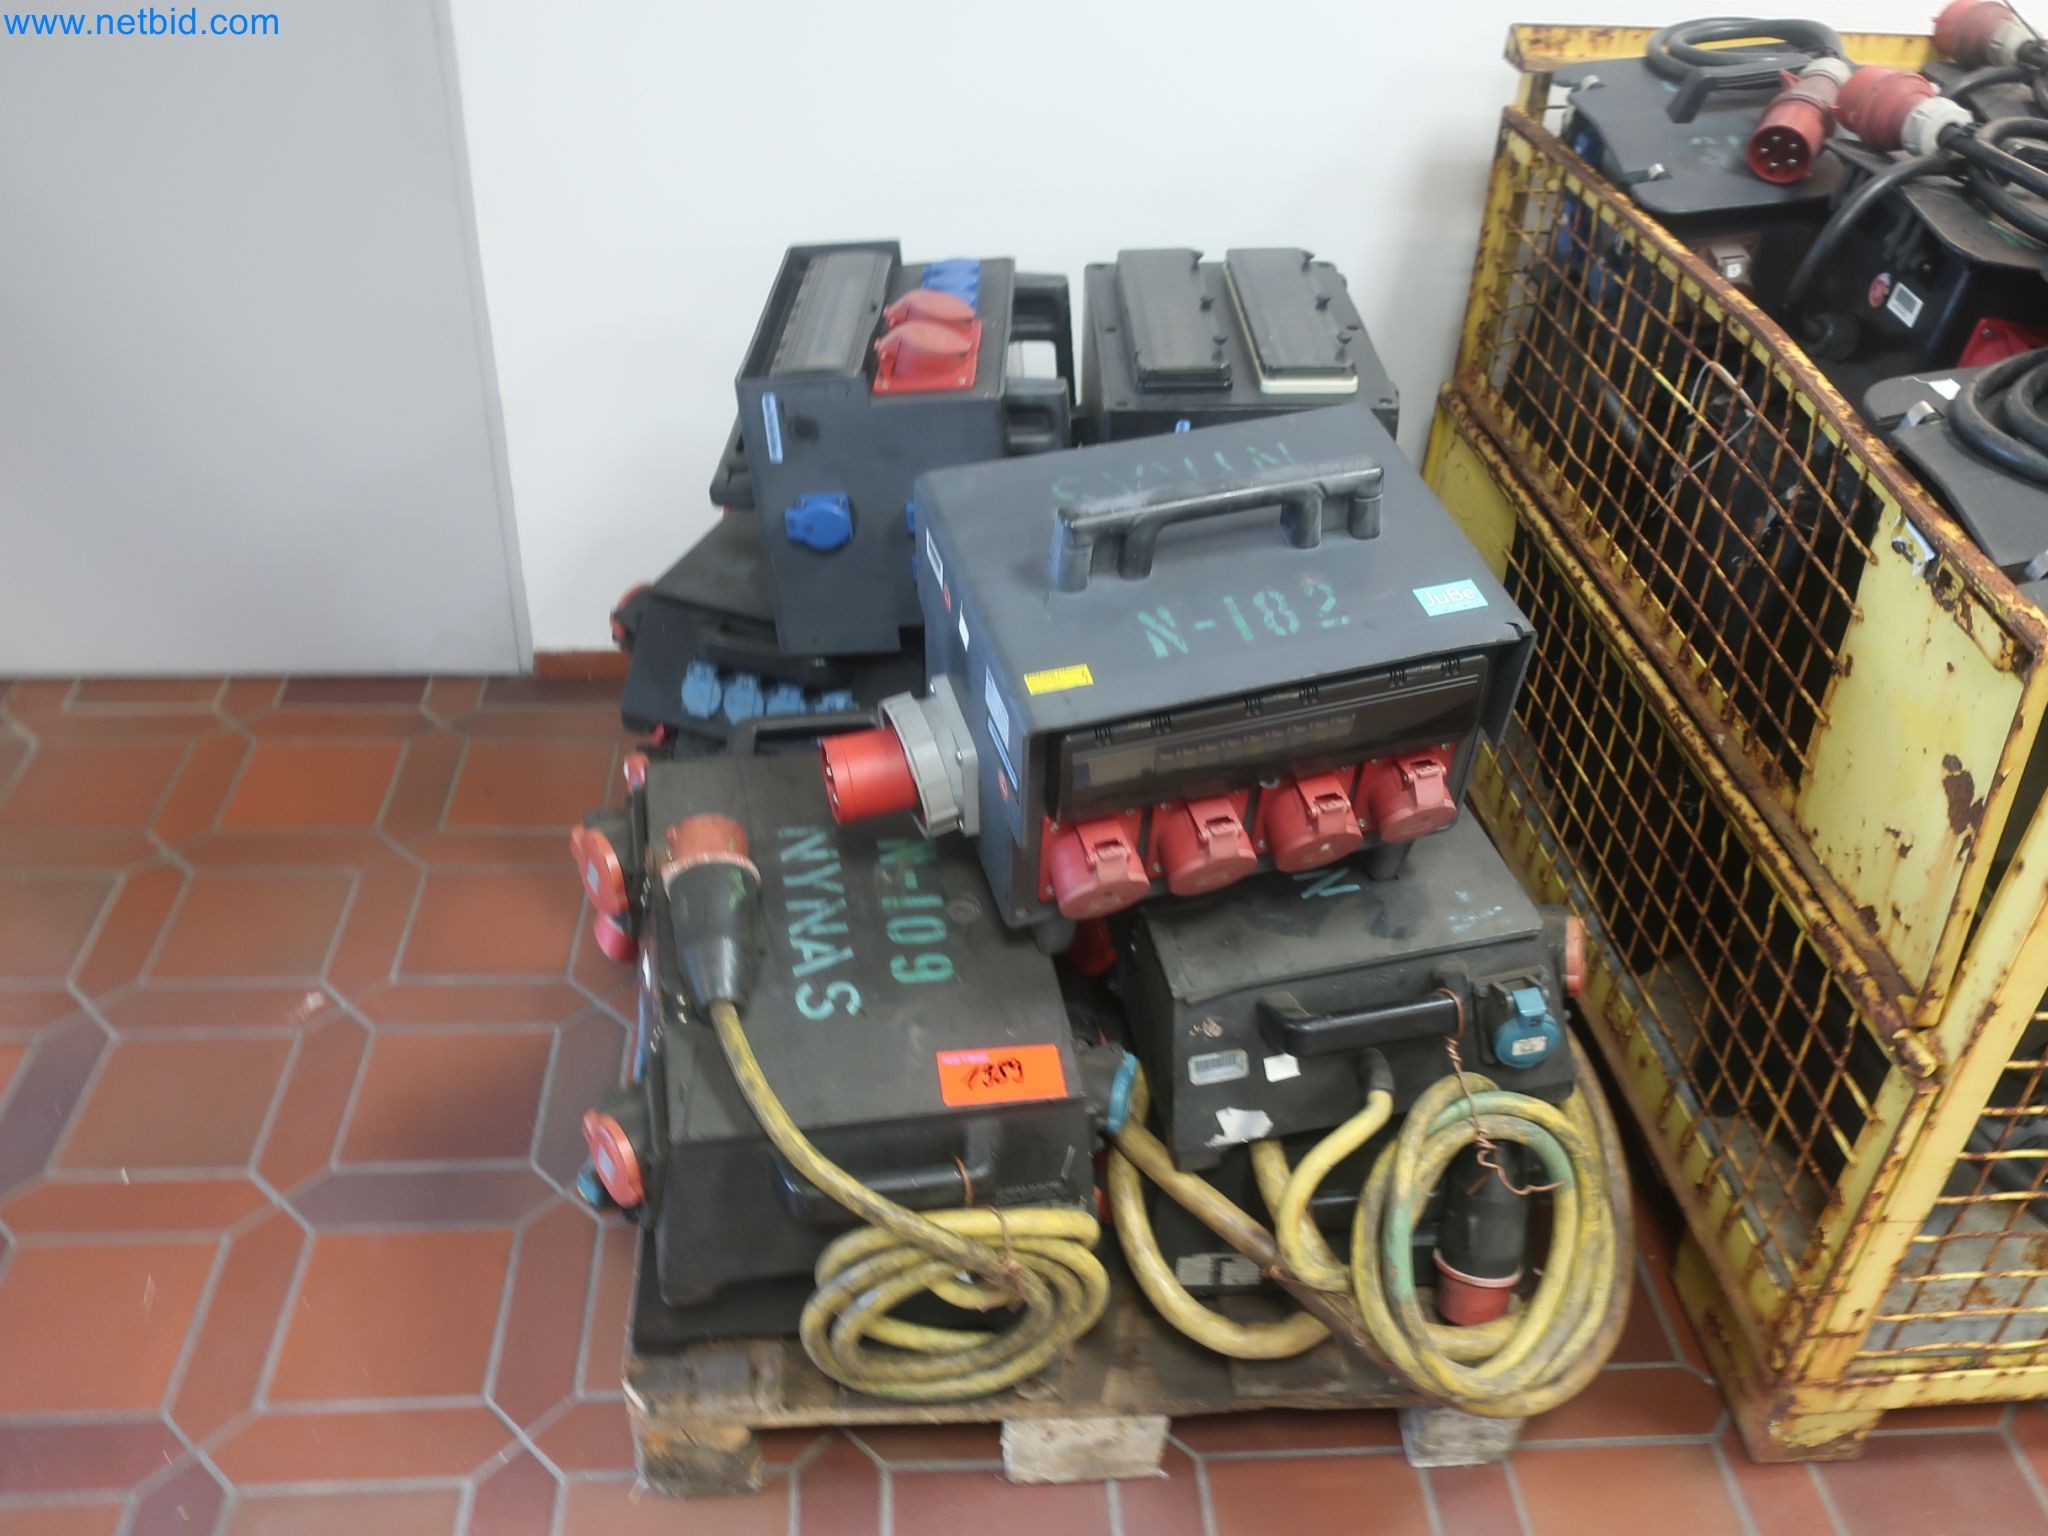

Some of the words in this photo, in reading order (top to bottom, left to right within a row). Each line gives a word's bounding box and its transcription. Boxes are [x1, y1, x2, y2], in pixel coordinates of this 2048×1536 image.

[1137, 583, 1349, 658] N-182
[777, 826, 862, 1020] NYNAS
[876, 838, 953, 984] N-109
